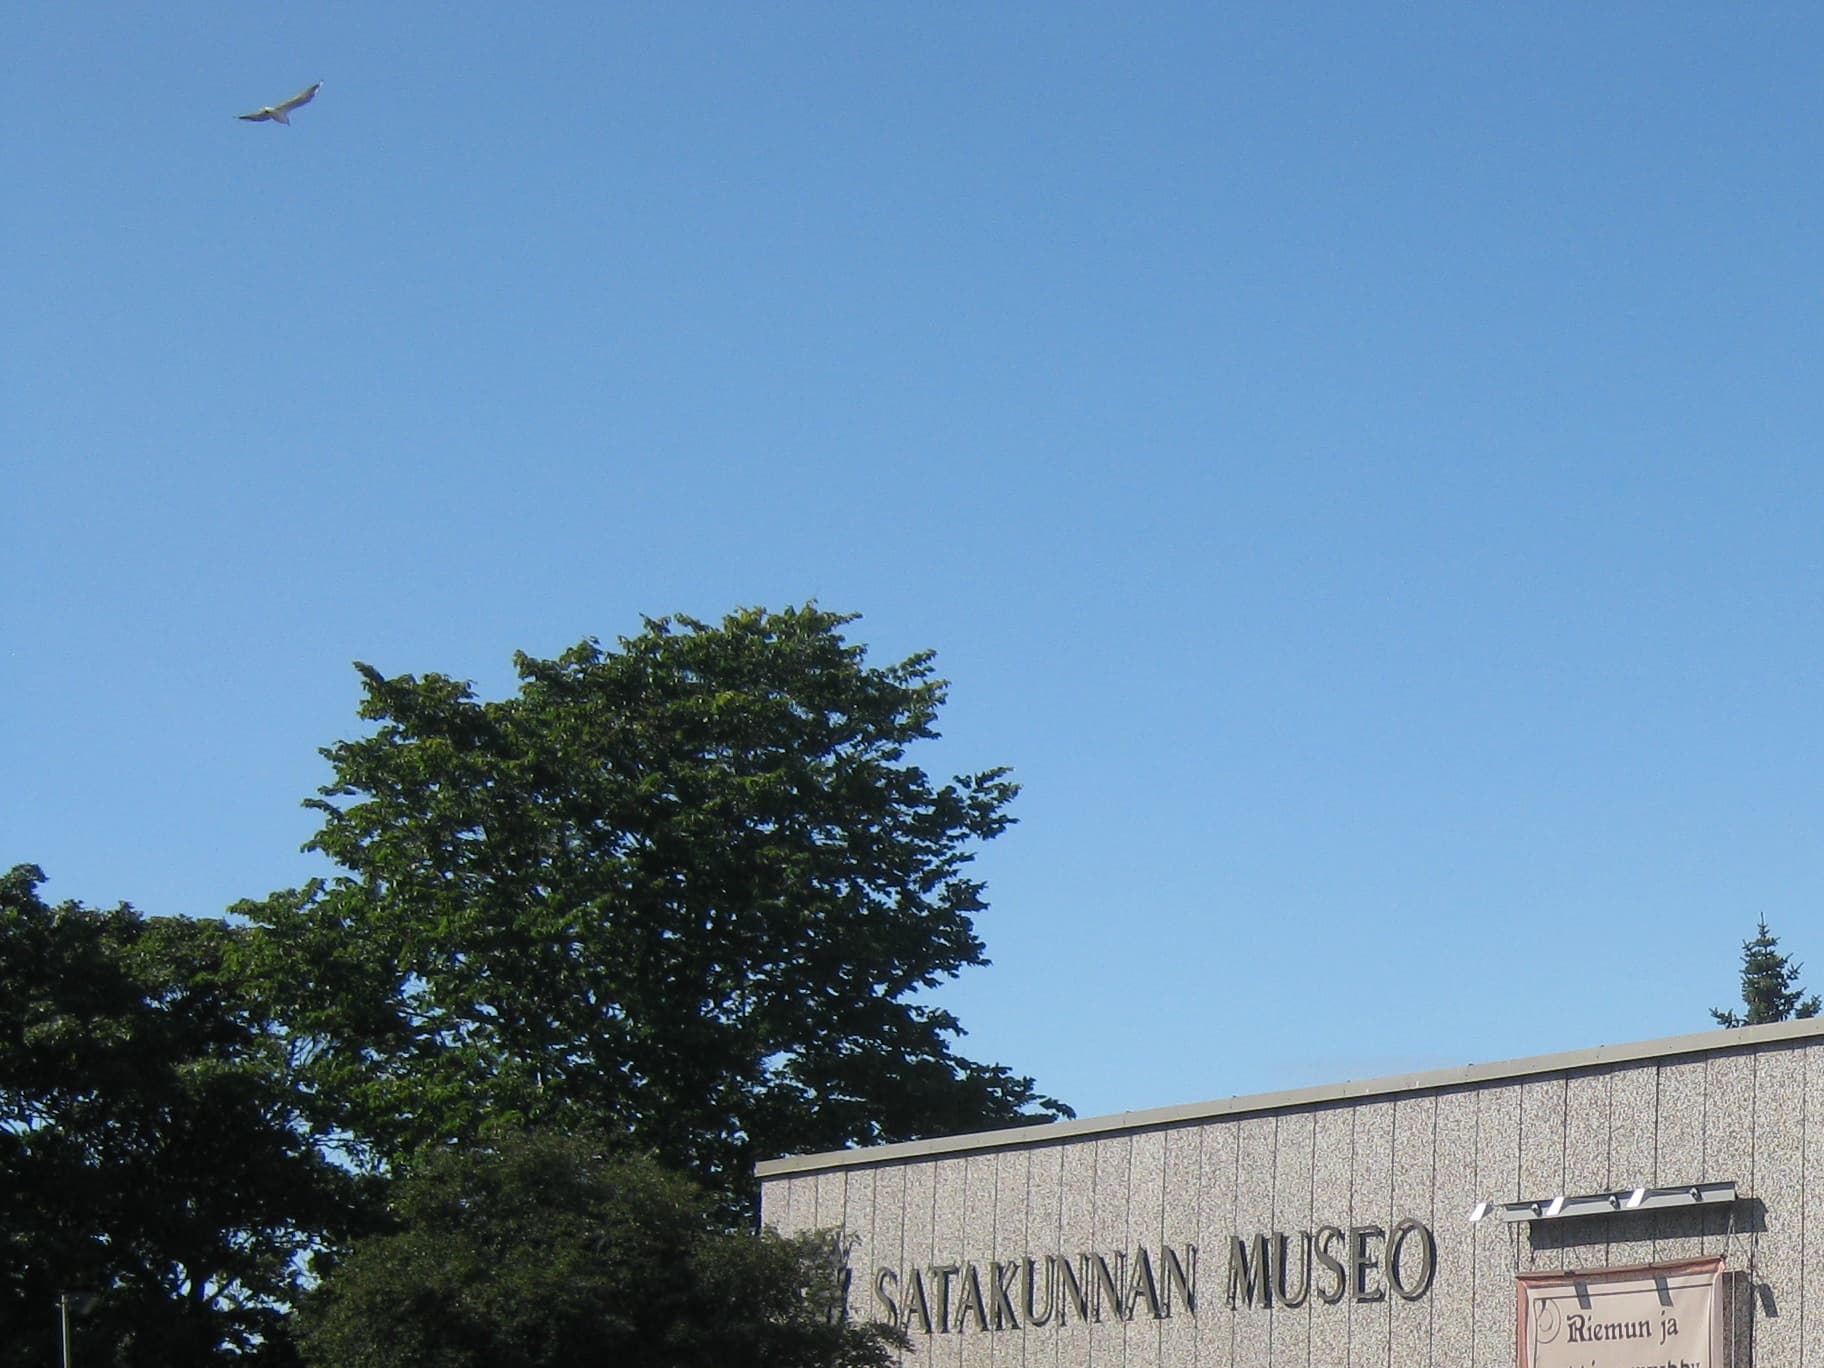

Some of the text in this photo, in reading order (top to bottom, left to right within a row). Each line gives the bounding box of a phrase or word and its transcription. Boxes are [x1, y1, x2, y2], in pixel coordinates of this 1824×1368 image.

[873, 1217, 1438, 1334] SATAKUNNAN MUSEO
[1566, 1310, 1679, 1345] Riemun ja
